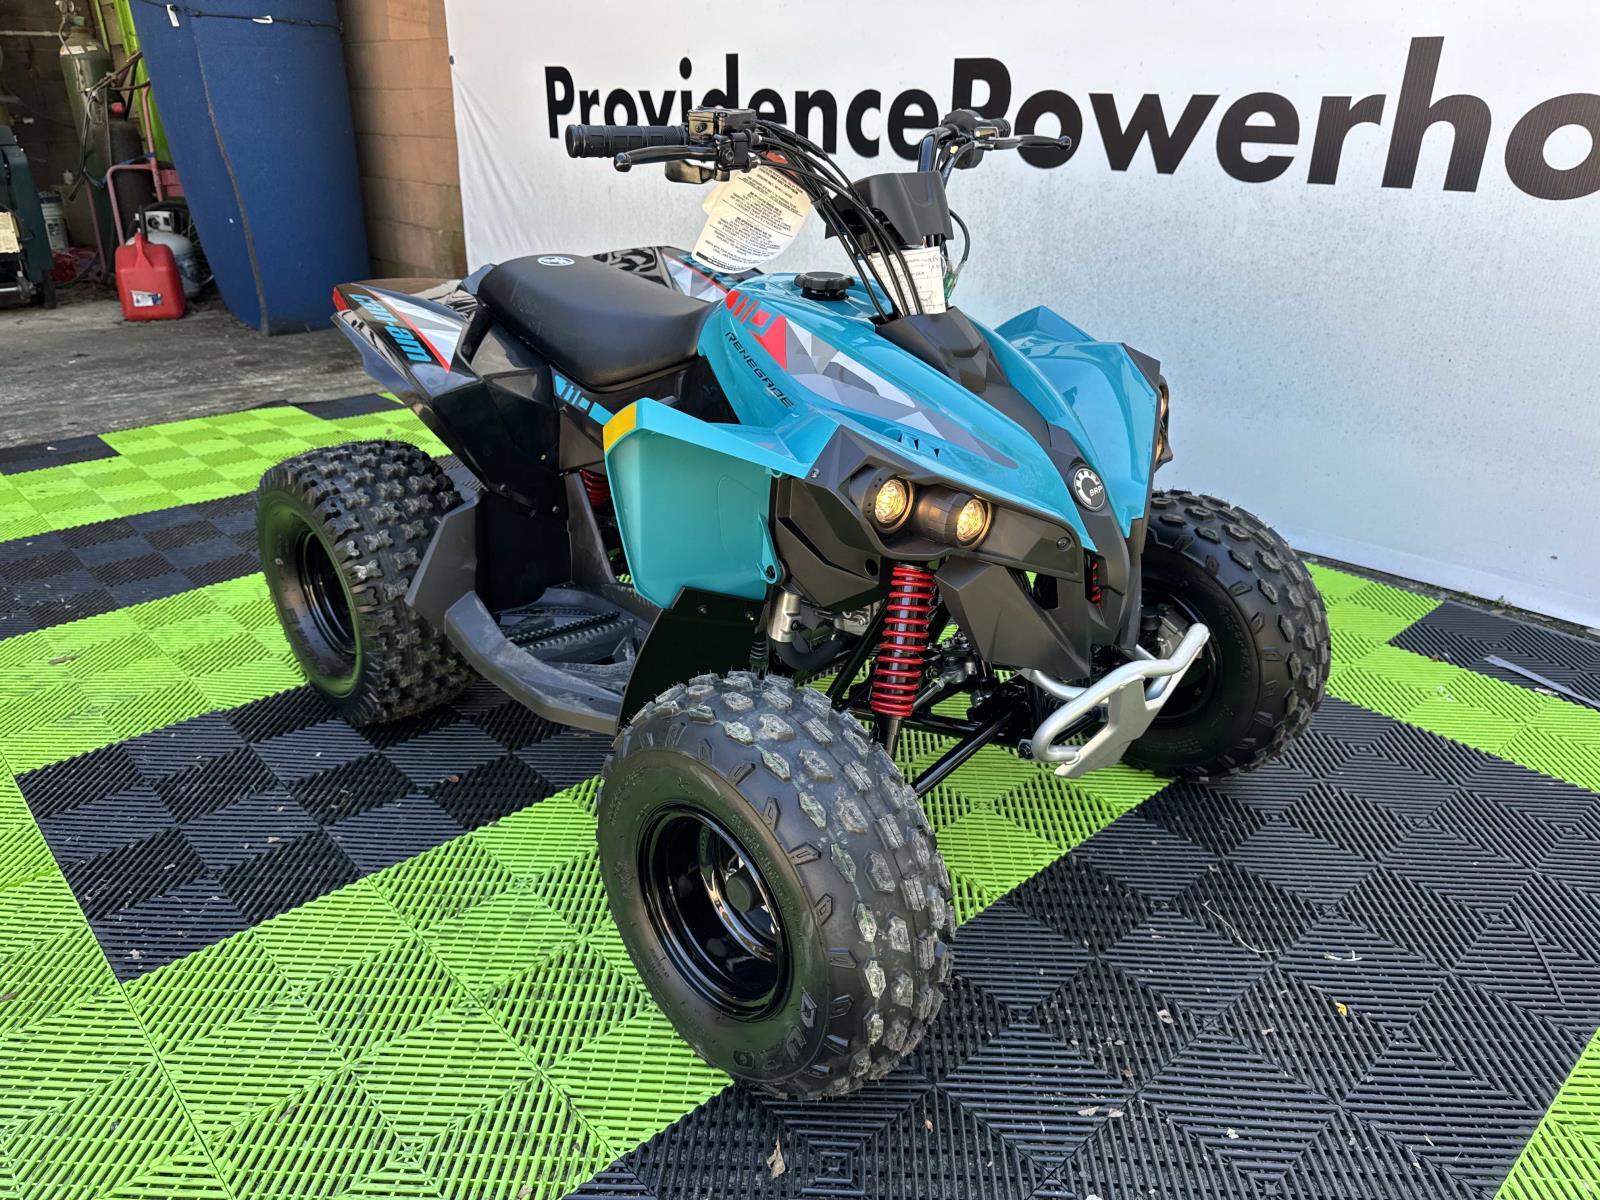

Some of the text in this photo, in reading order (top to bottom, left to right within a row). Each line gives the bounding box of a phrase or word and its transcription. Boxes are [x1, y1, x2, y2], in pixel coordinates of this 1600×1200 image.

[348, 293, 432, 362] can-am
[724, 331, 794, 408] RENEGADE
[1089, 485, 1103, 497] BRP
